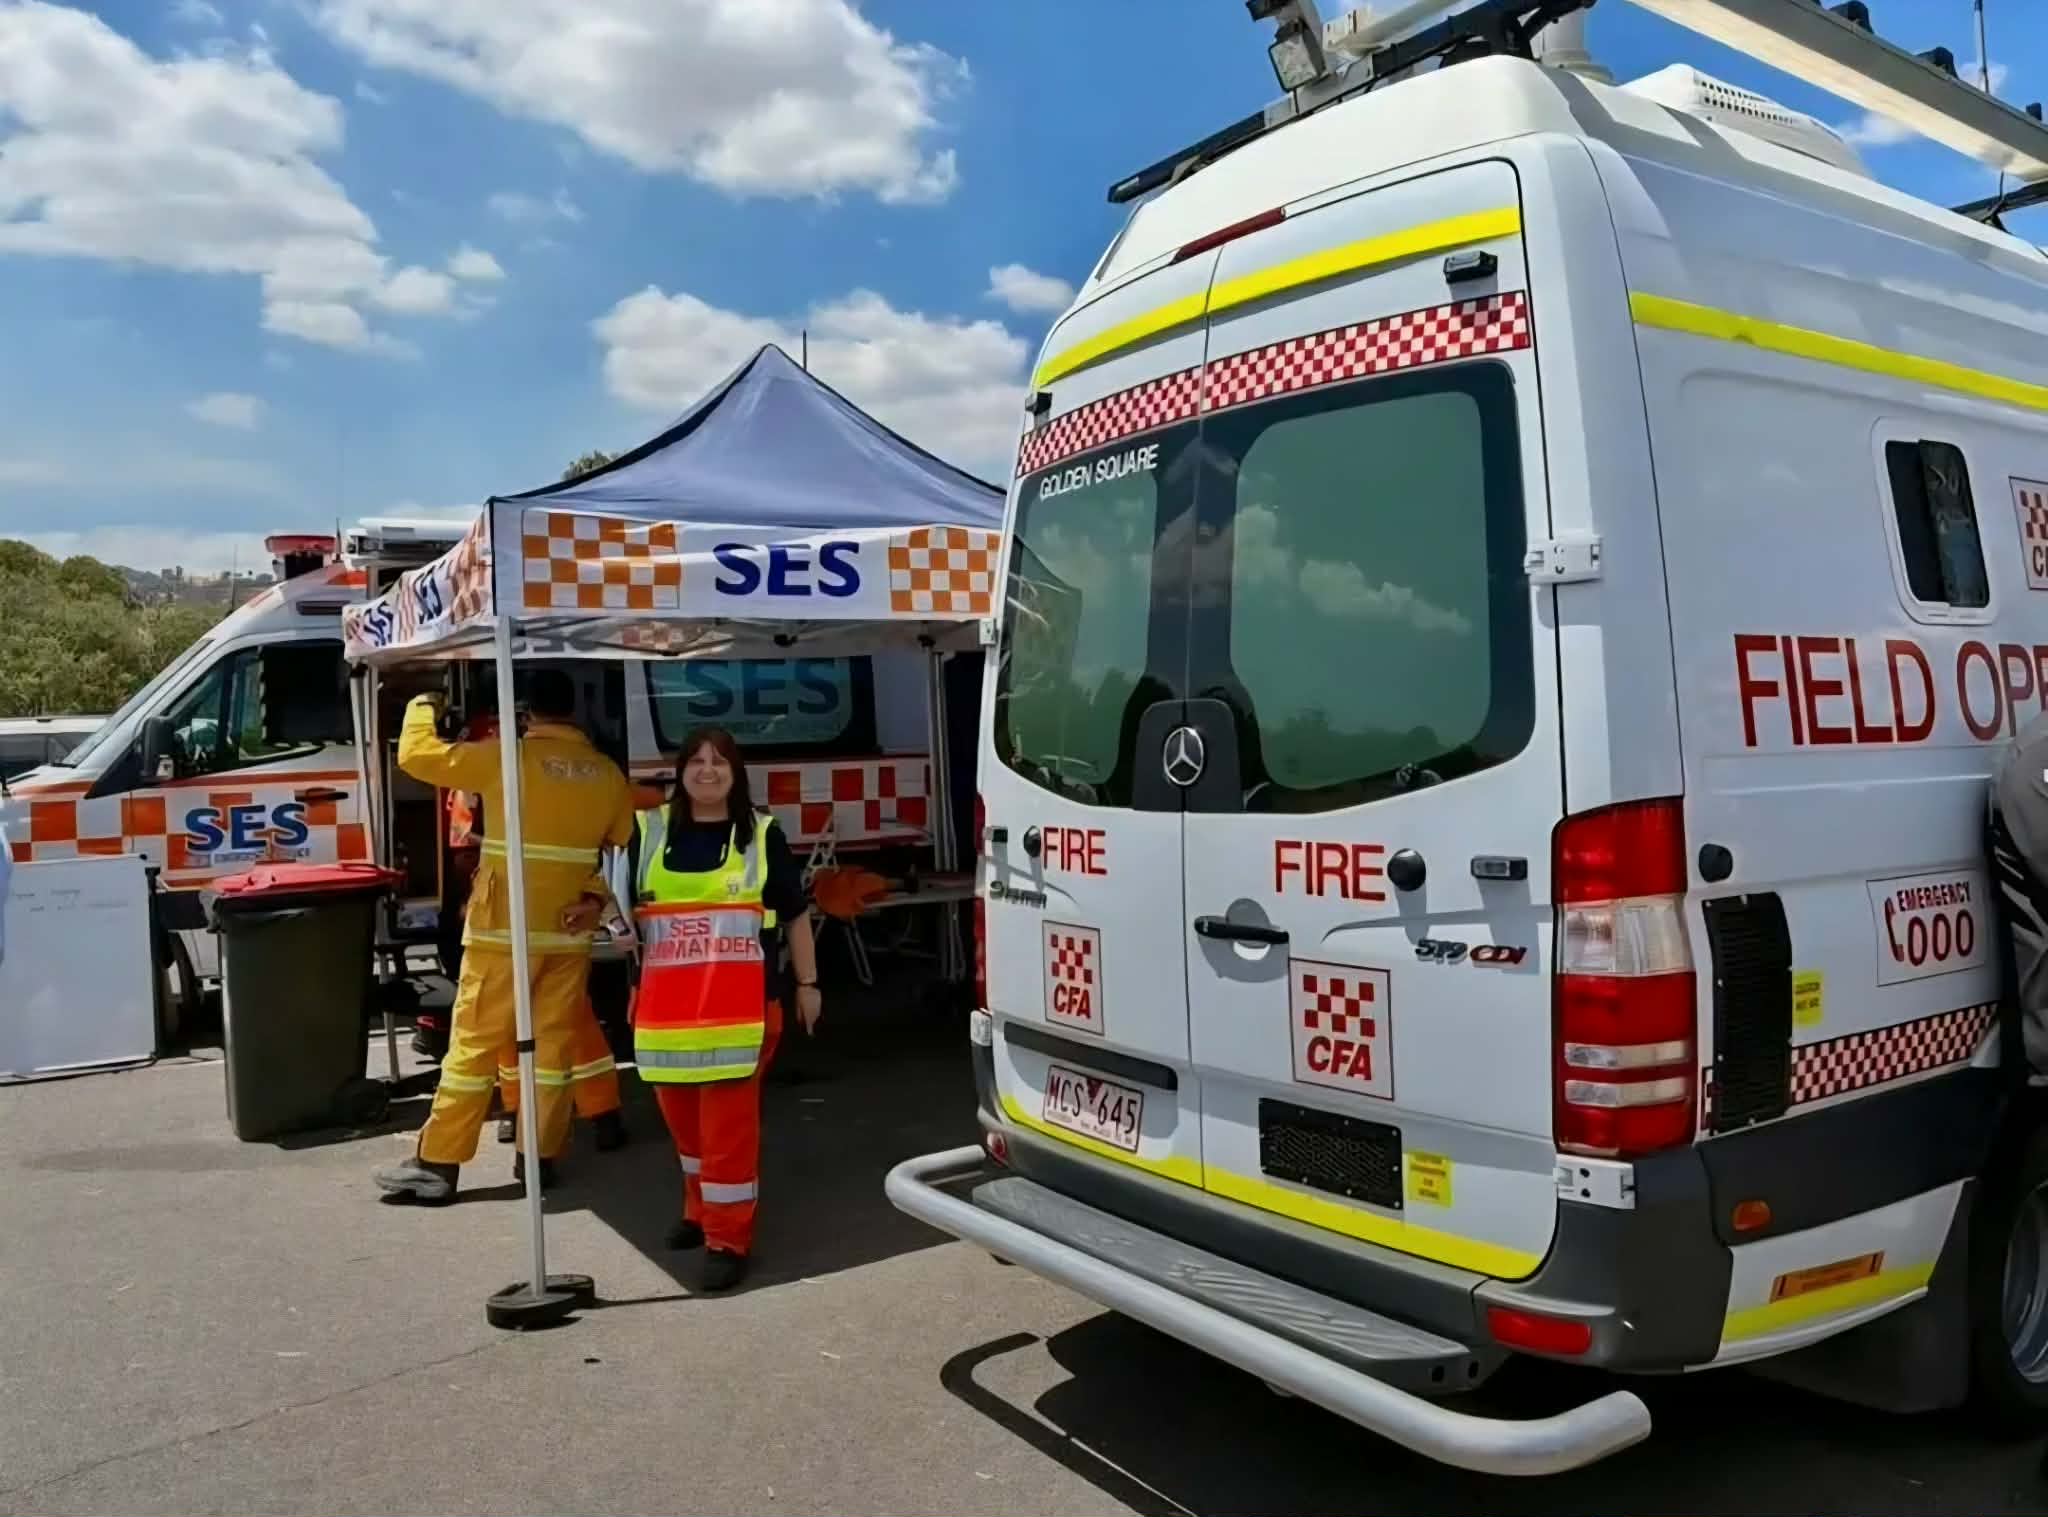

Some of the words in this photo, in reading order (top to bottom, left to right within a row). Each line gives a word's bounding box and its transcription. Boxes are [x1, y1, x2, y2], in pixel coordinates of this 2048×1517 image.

[1040, 462, 1094, 501] GOLDEN
[1095, 443, 1160, 484] SQUARE
[712, 541, 861, 597] SES
[680, 657, 840, 718] SES
[1734, 634, 1935, 747] FIELD
[185, 802, 309, 852] SES
[1043, 826, 1108, 876] FIRE
[1274, 839, 1386, 902] FIRE
[1896, 882, 1971, 912] EMERGENCY
[671, 917, 711, 938] SES
[1907, 909, 1974, 967] 000
[1053, 983, 1092, 1020] CFA
[1306, 1035, 1373, 1082] CFA
[1097, 1089, 1137, 1138] 645
